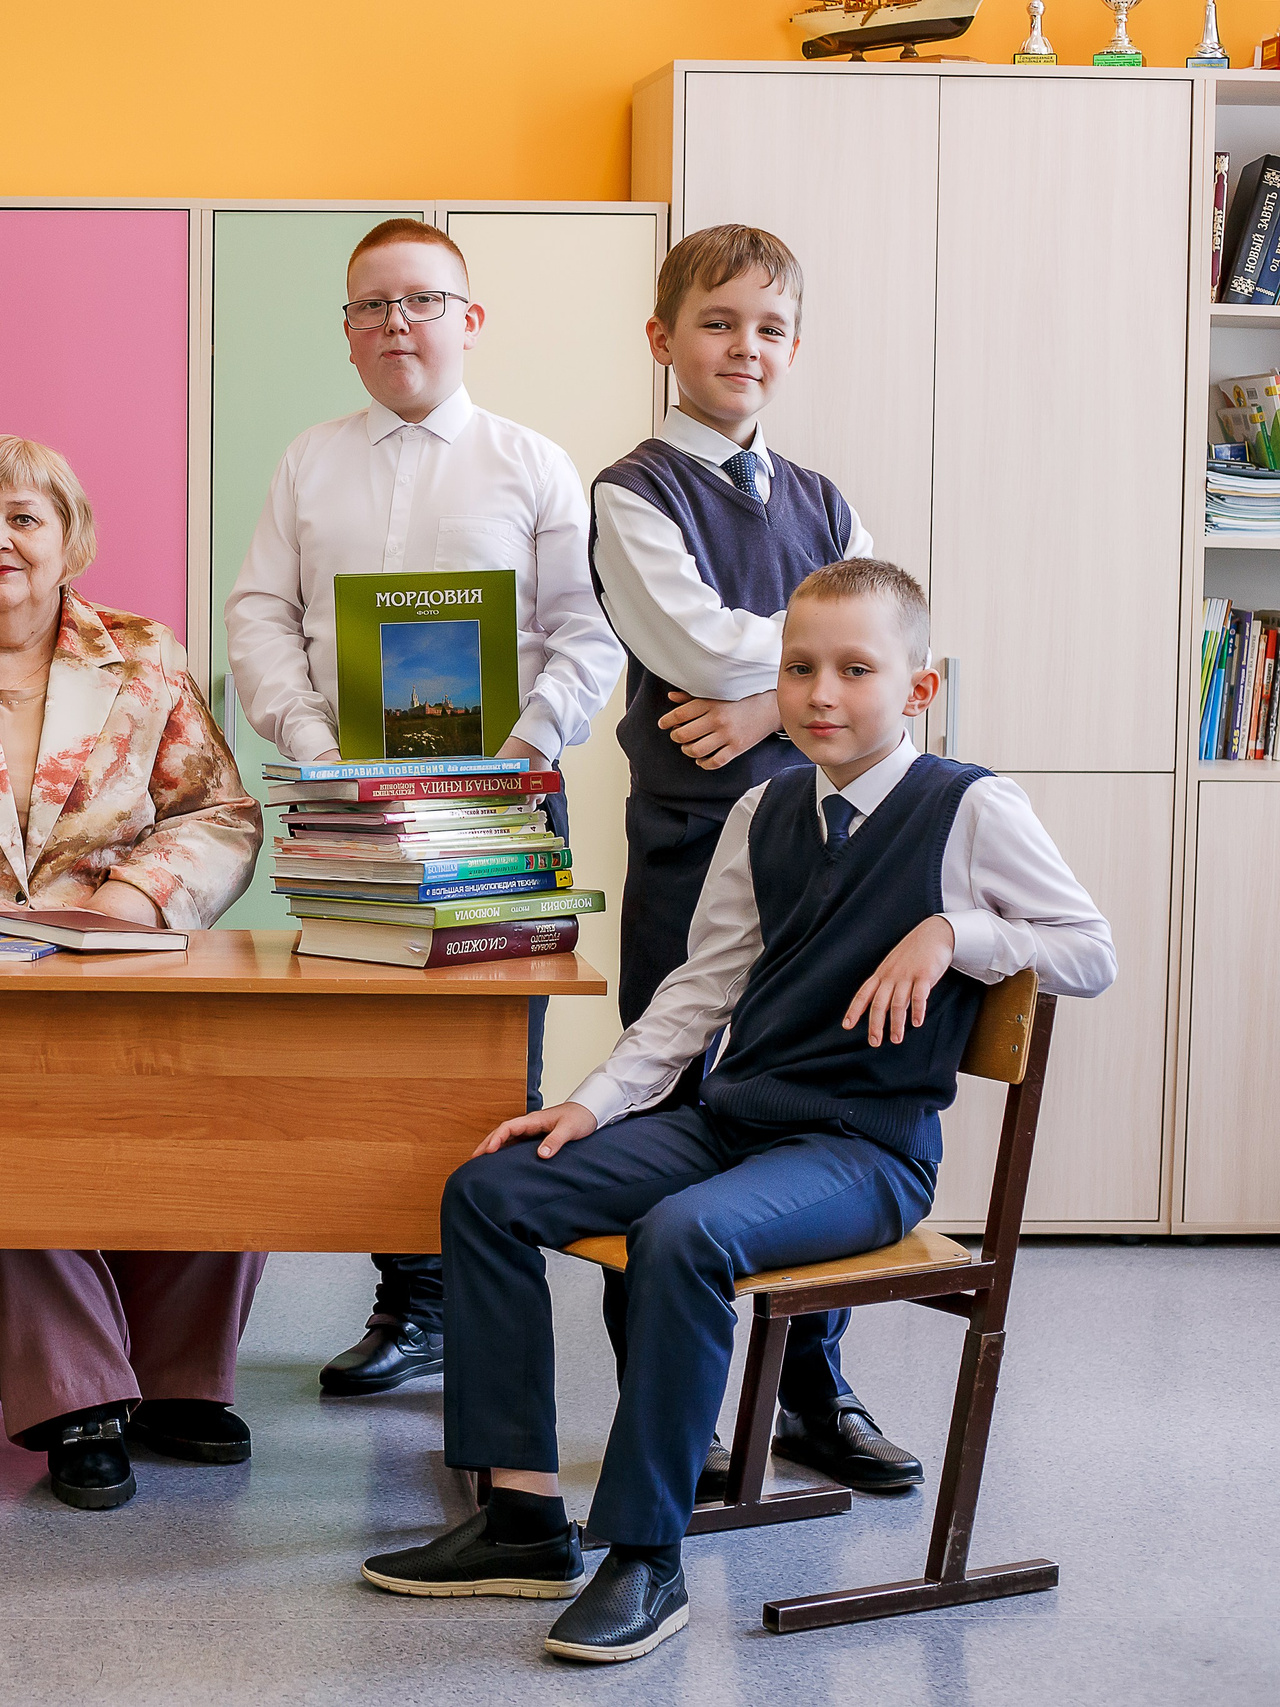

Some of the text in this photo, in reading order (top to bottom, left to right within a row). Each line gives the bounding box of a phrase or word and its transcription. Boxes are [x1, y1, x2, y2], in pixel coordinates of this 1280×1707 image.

[1244, 233, 1266, 274] НОВЫЙ
[375, 588, 483, 609] МОРДОВИЯ
[341, 766, 385, 777] ПРАВИЛА
[388, 764, 445, 776] ПОВЕДЕНИЯ
[459, 763, 501, 773] воспитанных
[420, 777, 523, 795] КРАСНАЯ КНИГА
[431, 885, 465, 896] БОЛЬШАЯ
[464, 881, 518, 894] ЭНЦИКЛОПЕДИЯ
[455, 905, 530, 921] PHOTO MORDOVIA
[540, 897, 593, 913] МОРДОВИЯ
